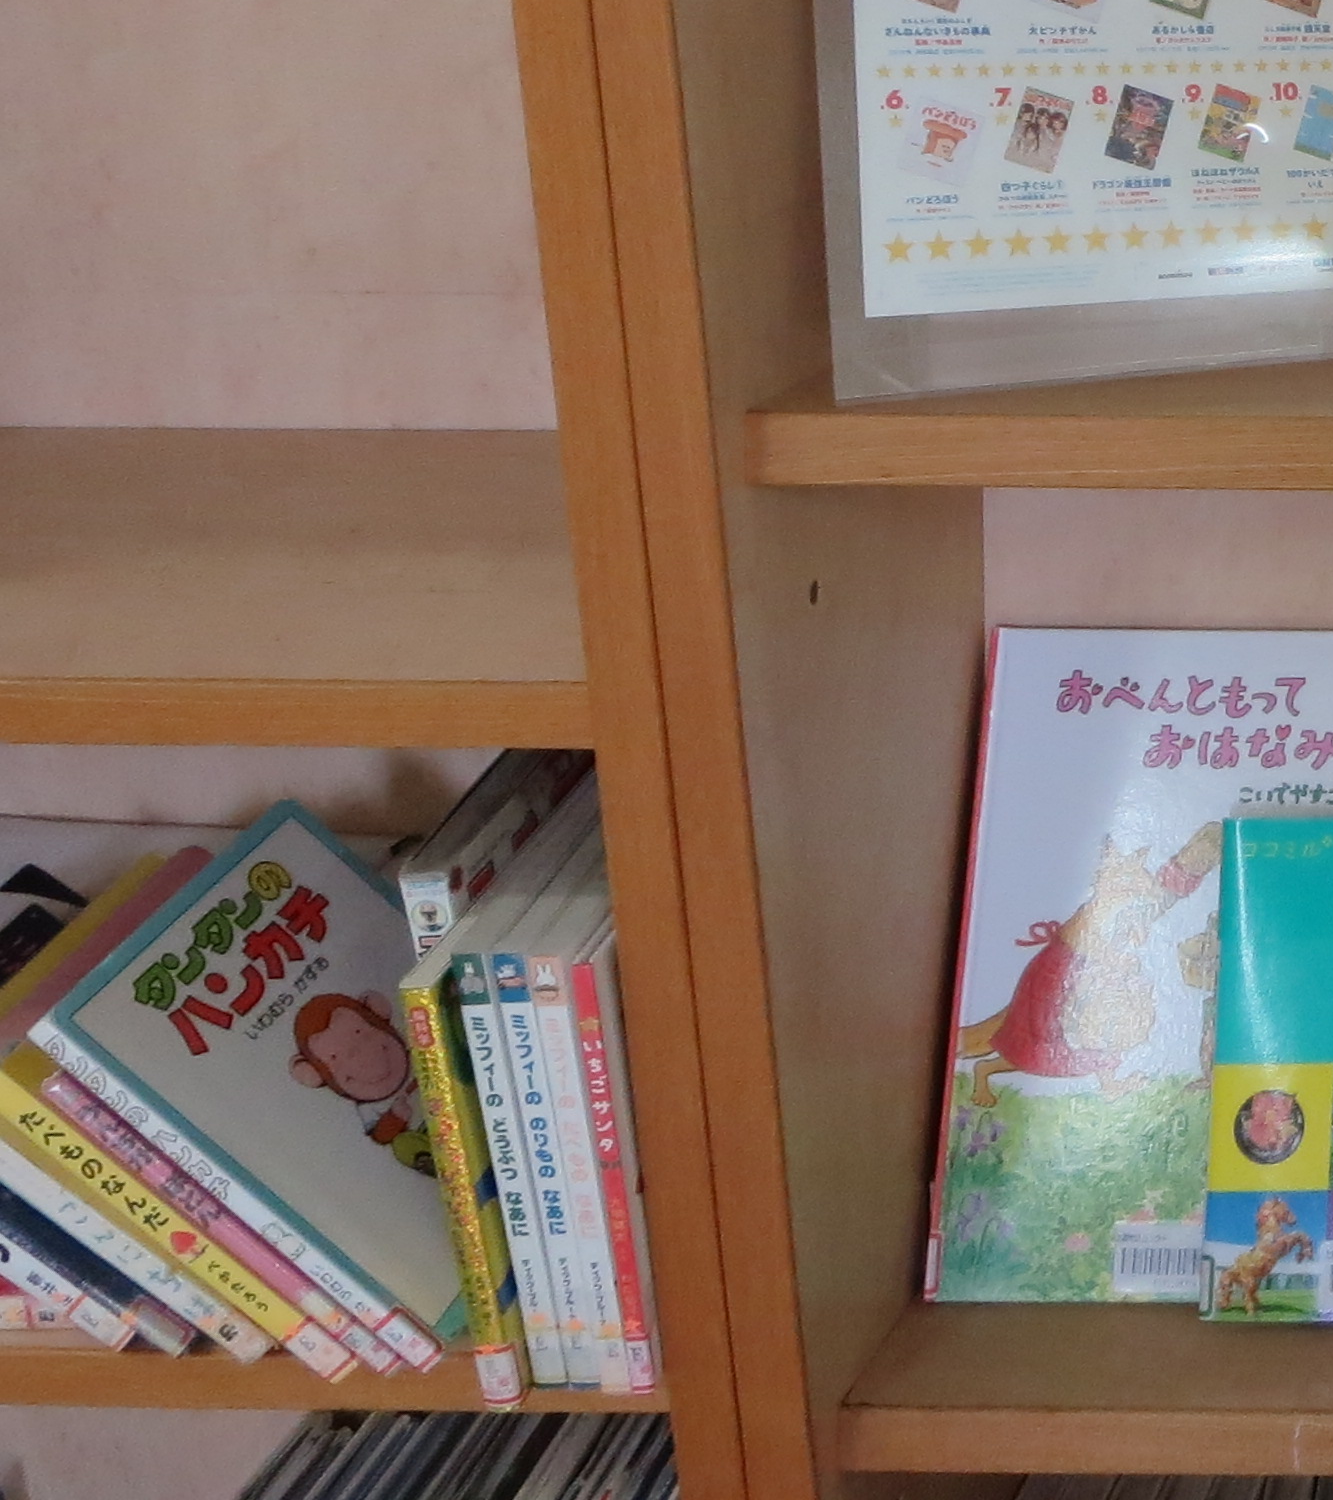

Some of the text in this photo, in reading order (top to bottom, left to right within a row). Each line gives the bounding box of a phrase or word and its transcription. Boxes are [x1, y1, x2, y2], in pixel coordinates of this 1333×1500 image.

[1056, 668, 1306, 718] おべんともって
[168, 885, 330, 1056] ハンカチ
[469, 1016, 504, 1108] ミッフィーの
[510, 1014, 543, 1106] ミッフィーの
[582, 1040, 614, 1152] いちごサンタ
[18, 1111, 170, 1232] たべものなんだ
